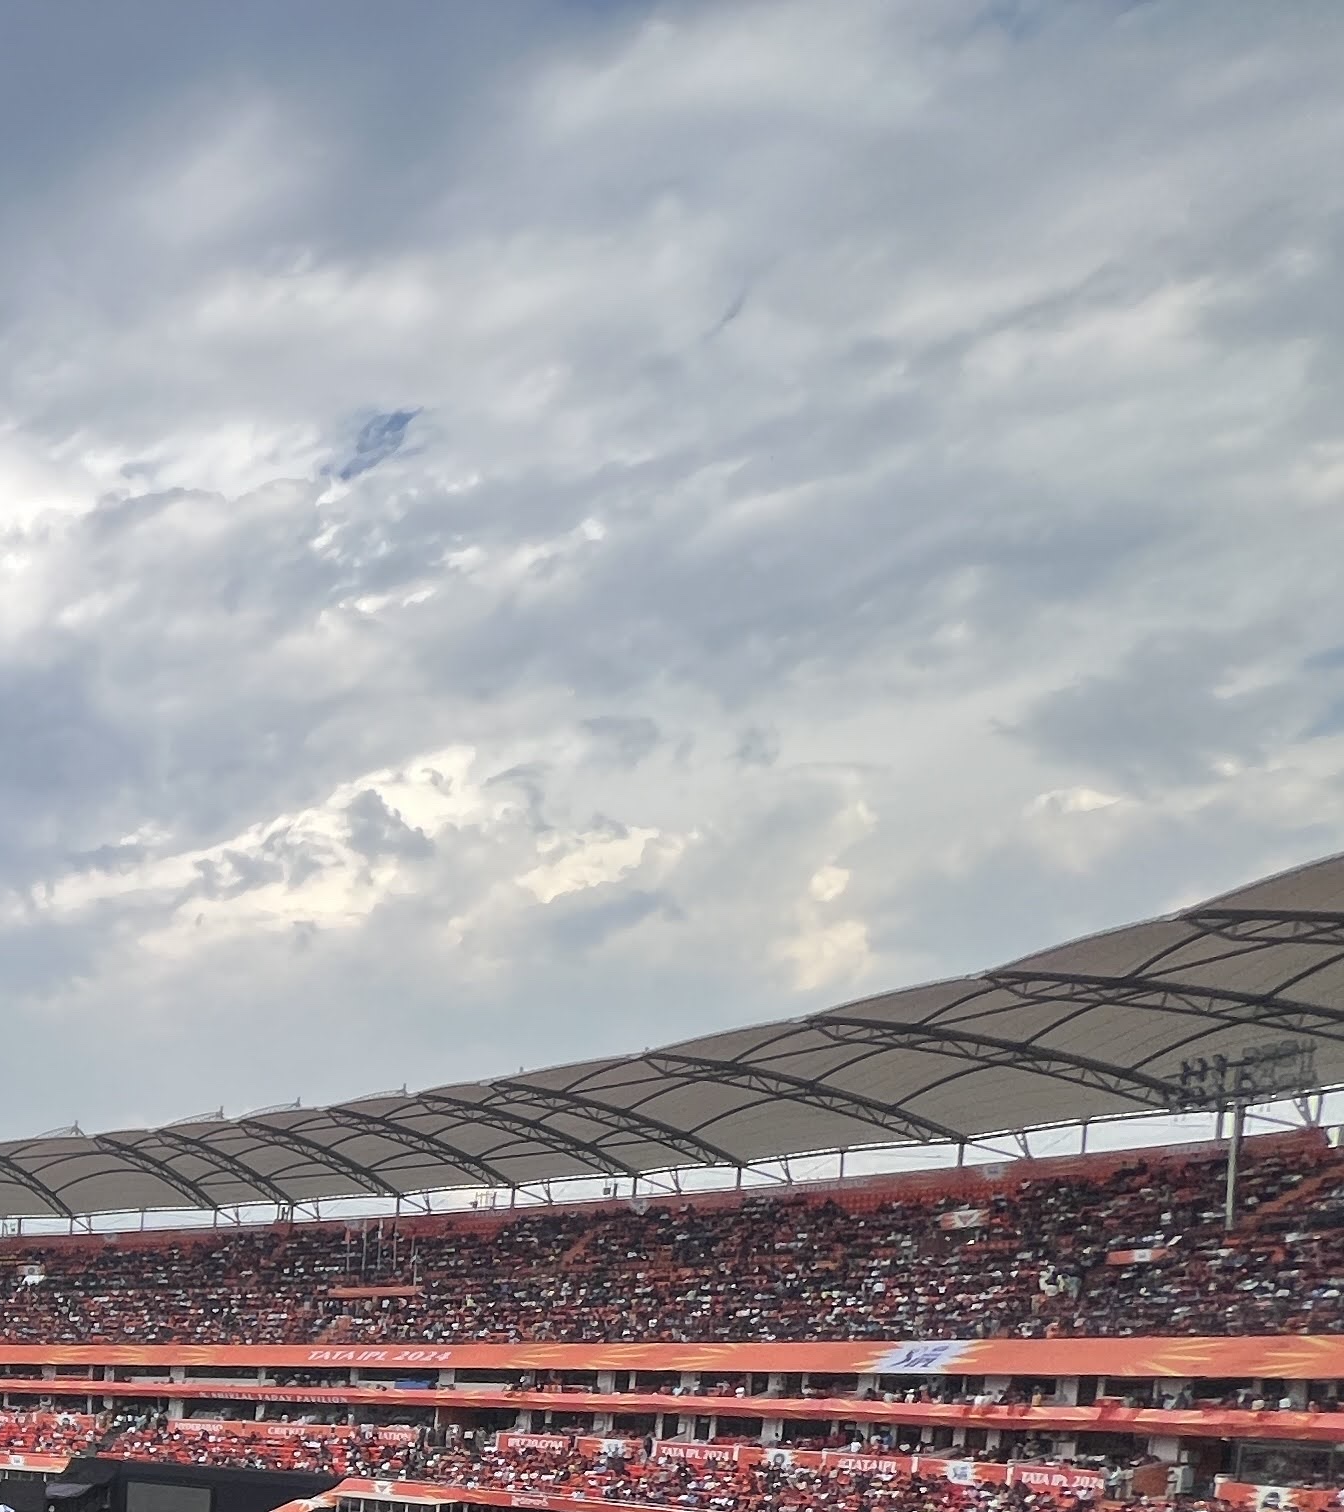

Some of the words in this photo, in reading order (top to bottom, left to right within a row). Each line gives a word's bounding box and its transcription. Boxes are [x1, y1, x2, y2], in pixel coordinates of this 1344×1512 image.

[307, 1350, 355, 1361] TATA
[356, 1350, 386, 1361] IPL
[392, 1350, 451, 1361] 2024
[1022, 1471, 1048, 1486] TATA
